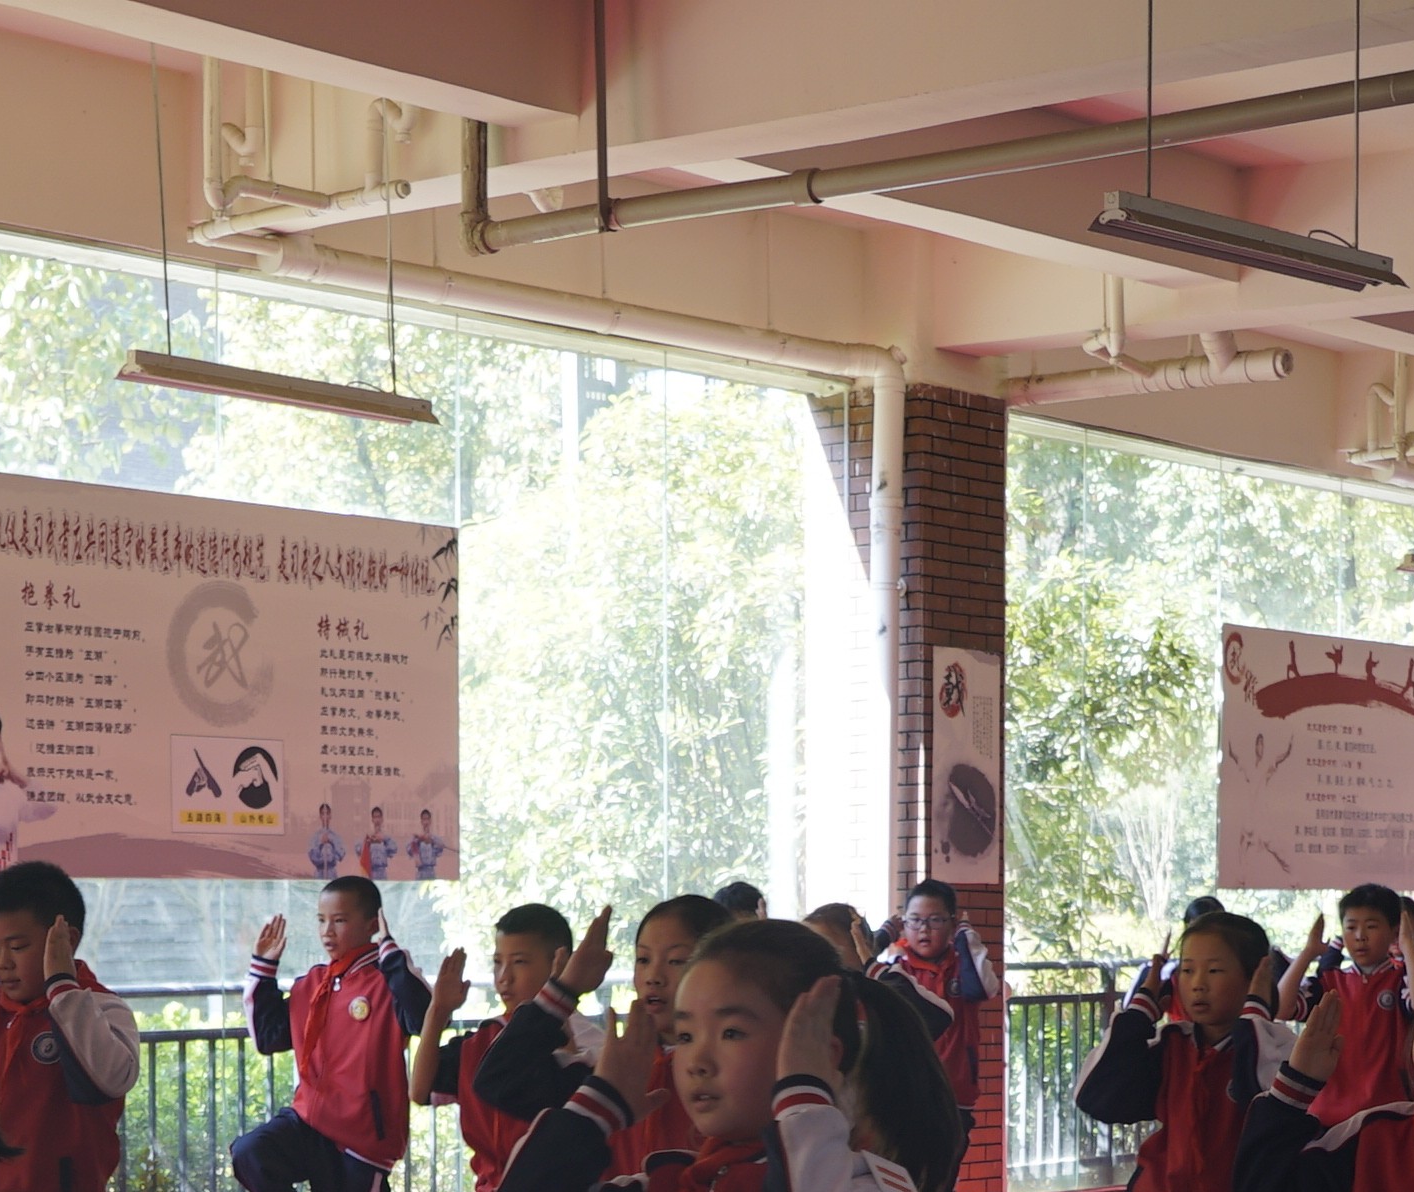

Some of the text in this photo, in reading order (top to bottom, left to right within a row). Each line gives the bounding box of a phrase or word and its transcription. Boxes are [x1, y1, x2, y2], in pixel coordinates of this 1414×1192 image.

[21, 580, 80, 610] 抱拳礼
[317, 614, 369, 643] 持械礼
